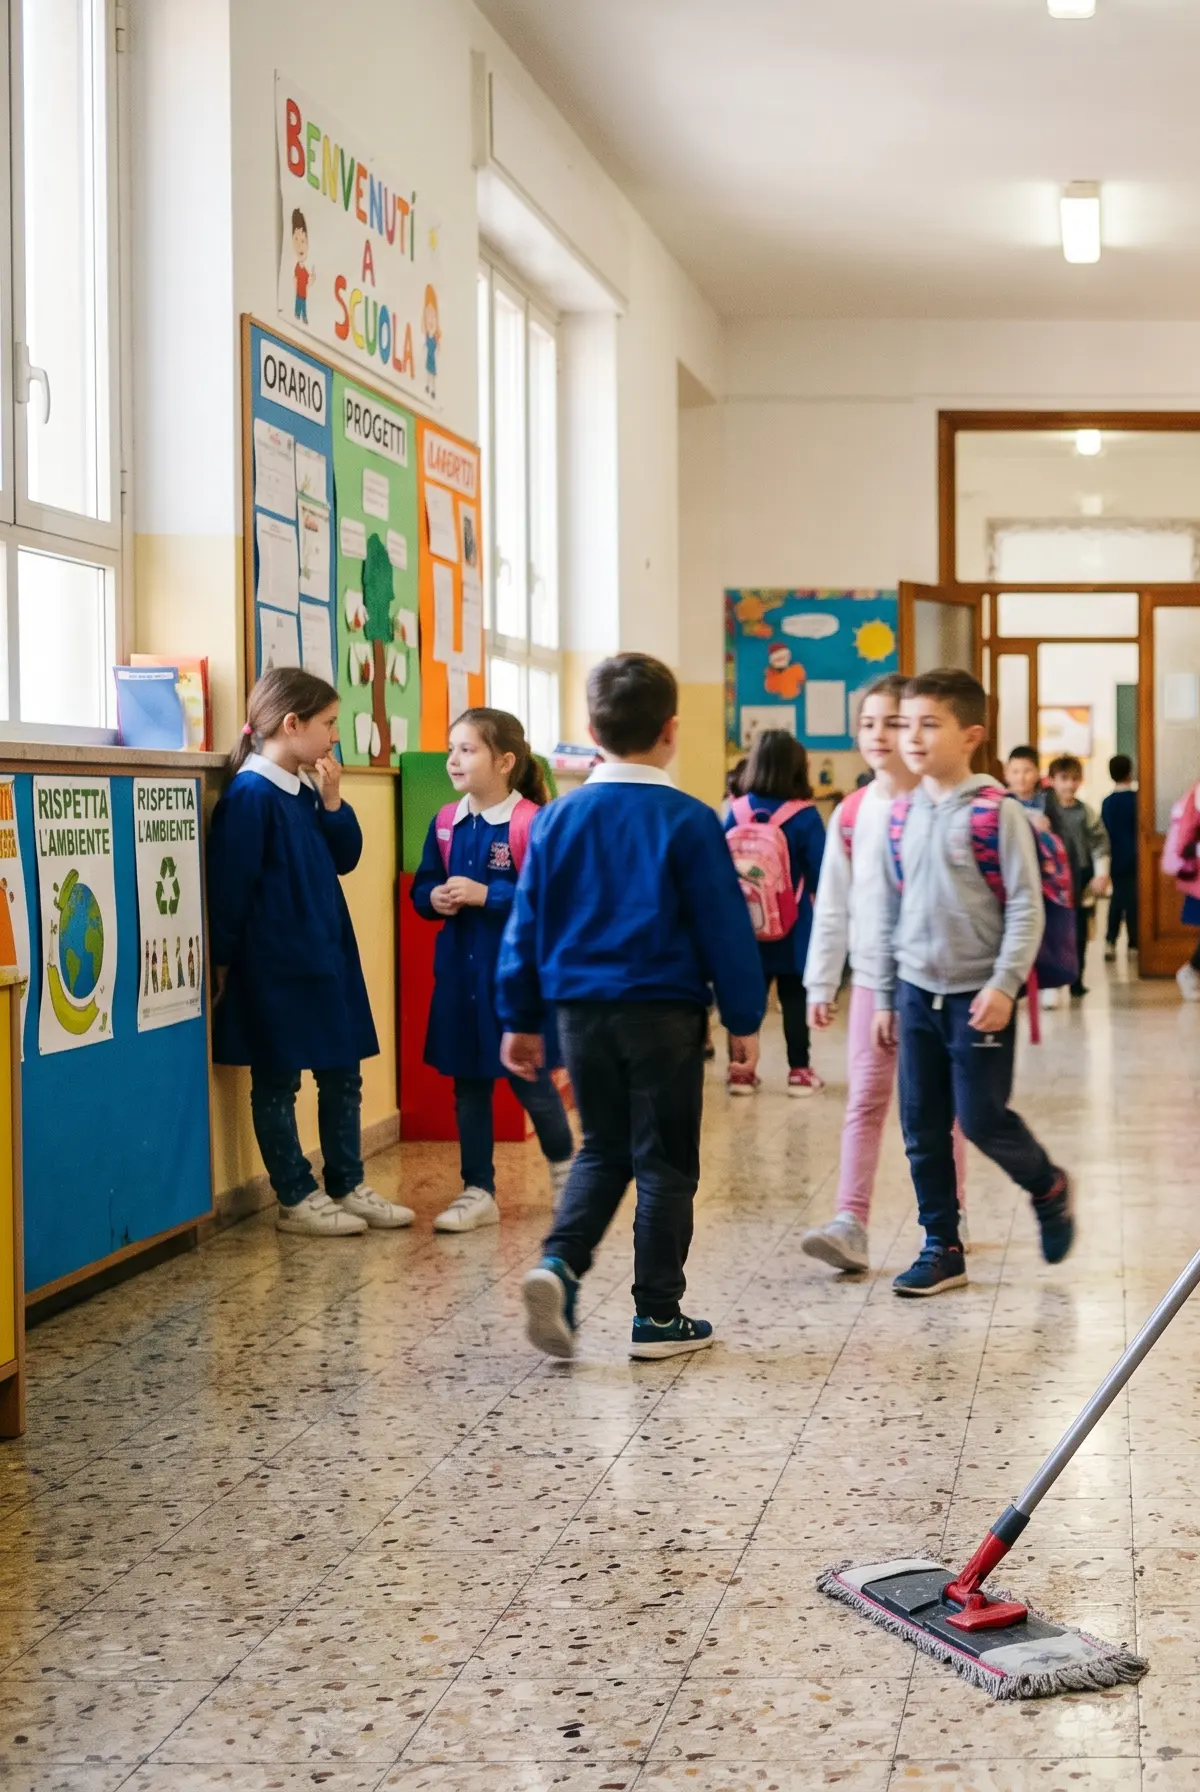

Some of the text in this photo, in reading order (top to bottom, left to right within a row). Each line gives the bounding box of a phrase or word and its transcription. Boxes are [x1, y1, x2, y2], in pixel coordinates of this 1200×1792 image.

[362, 239, 375, 287] A
[334, 275, 415, 379] SCUOLA
[263, 354, 323, 413] ORARIO
[346, 398, 405, 457] PROGETTI
[38, 788, 109, 820] RISPETTA
[137, 787, 195, 811] RISPETTA
[39, 828, 110, 857] L'AMBIENTE
[138, 818, 196, 843] L'AMBIENTE
